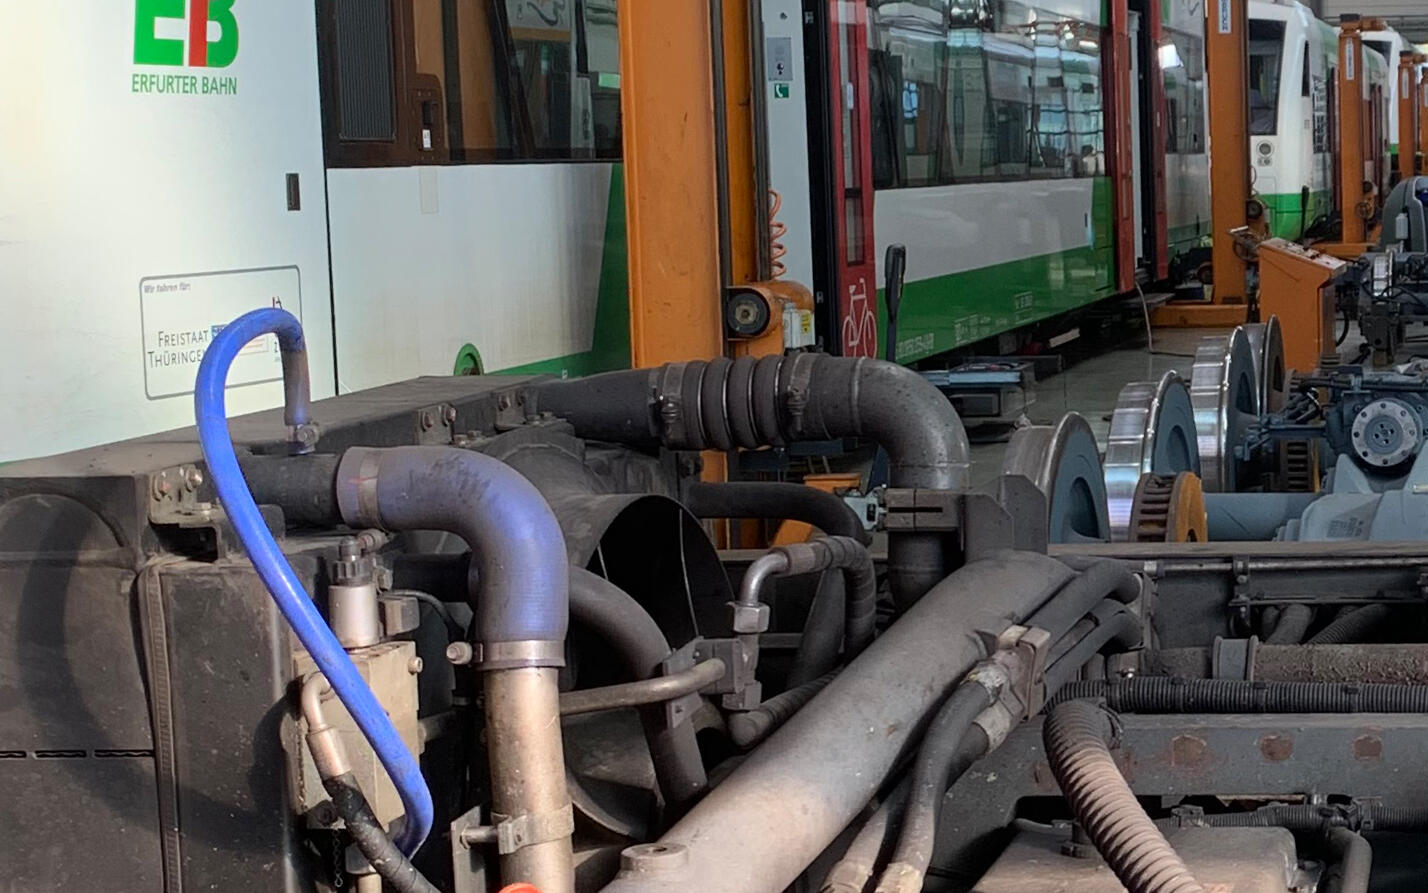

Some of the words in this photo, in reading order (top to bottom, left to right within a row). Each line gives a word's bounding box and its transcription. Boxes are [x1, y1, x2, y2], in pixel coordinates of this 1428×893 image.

[131, 73, 198, 94] ERFURTER
[201, 76, 237, 95] BAHN
[157, 329, 209, 348] FREISTAAT
[147, 349, 204, 368] THÜRINGE
